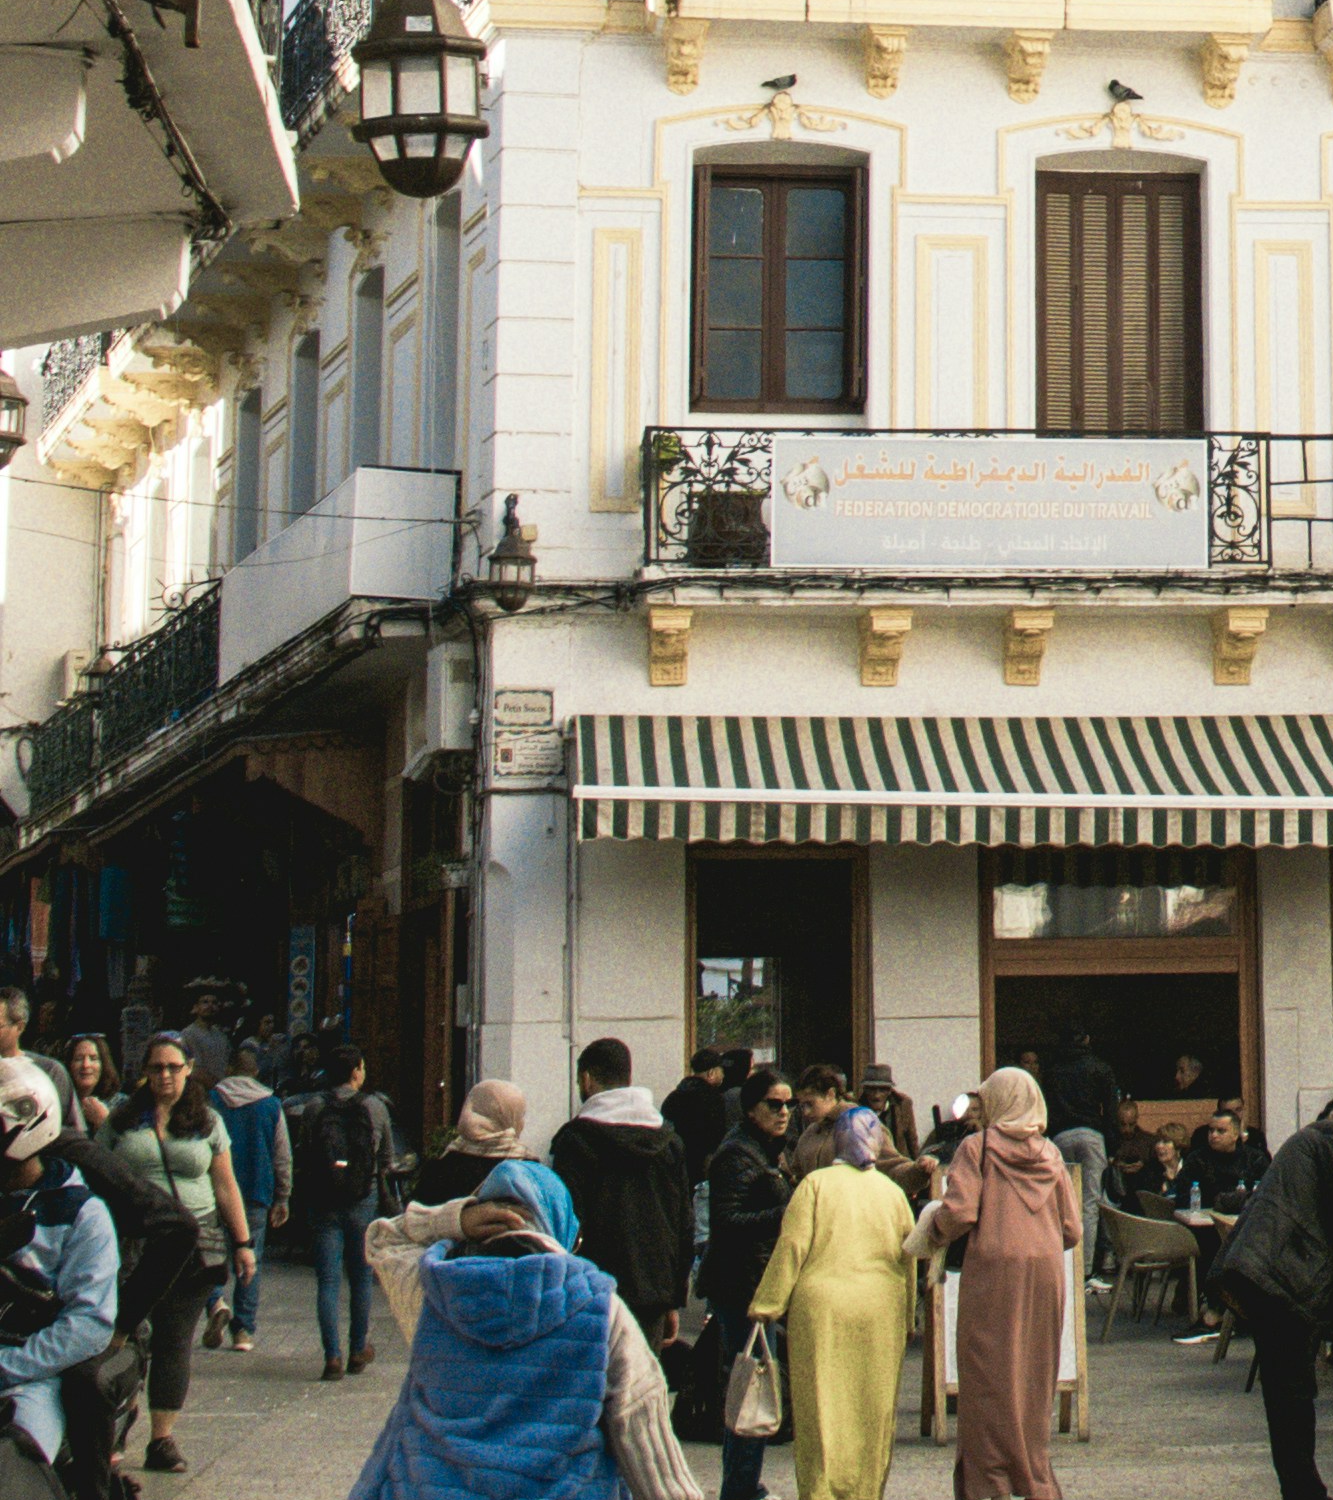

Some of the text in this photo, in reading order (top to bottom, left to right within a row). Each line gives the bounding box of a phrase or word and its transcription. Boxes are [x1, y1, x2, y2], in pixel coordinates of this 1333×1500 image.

[834, 451, 917, 487] للشغل
[1053, 456, 1151, 491] الفدرالية
[835, 500, 1153, 520] FEDERATION DEMOCRATIQUE DU TRAVAIL
